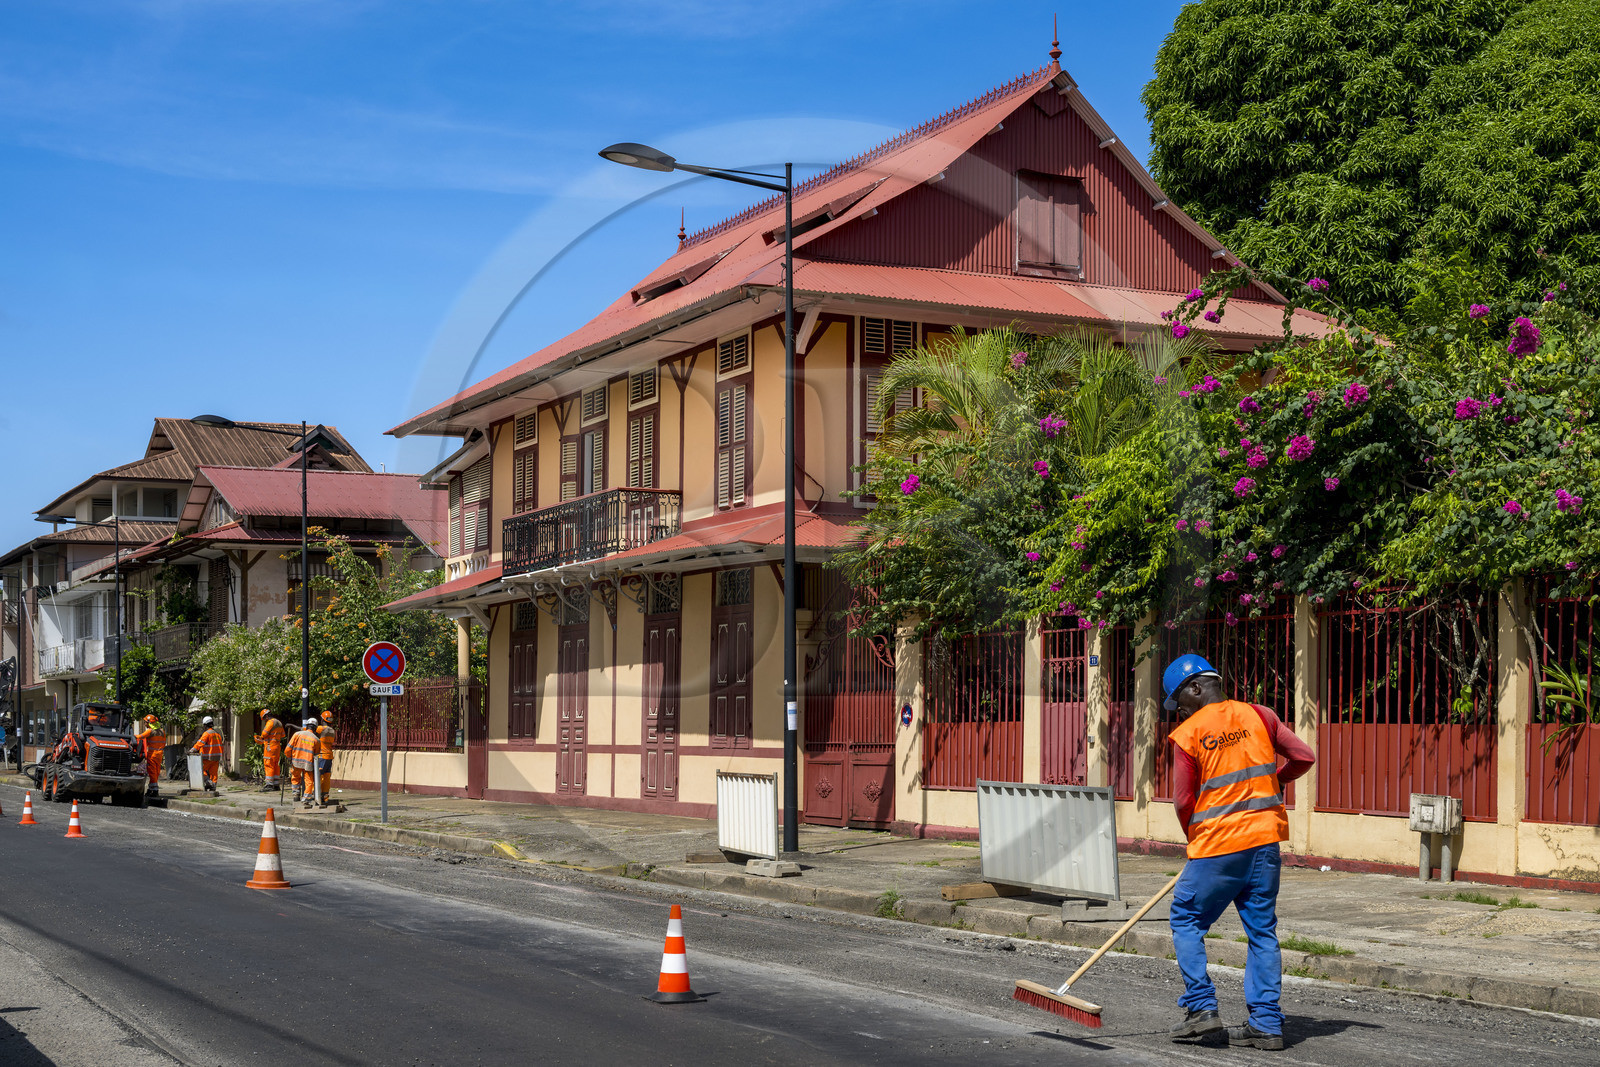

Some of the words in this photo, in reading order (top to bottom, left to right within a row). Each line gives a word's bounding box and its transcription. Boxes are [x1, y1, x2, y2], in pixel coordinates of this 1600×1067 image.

[372, 686, 391, 694] SAUF
[1201, 728, 1251, 751] Galopin
[1218, 740, 1238, 751] groupe
